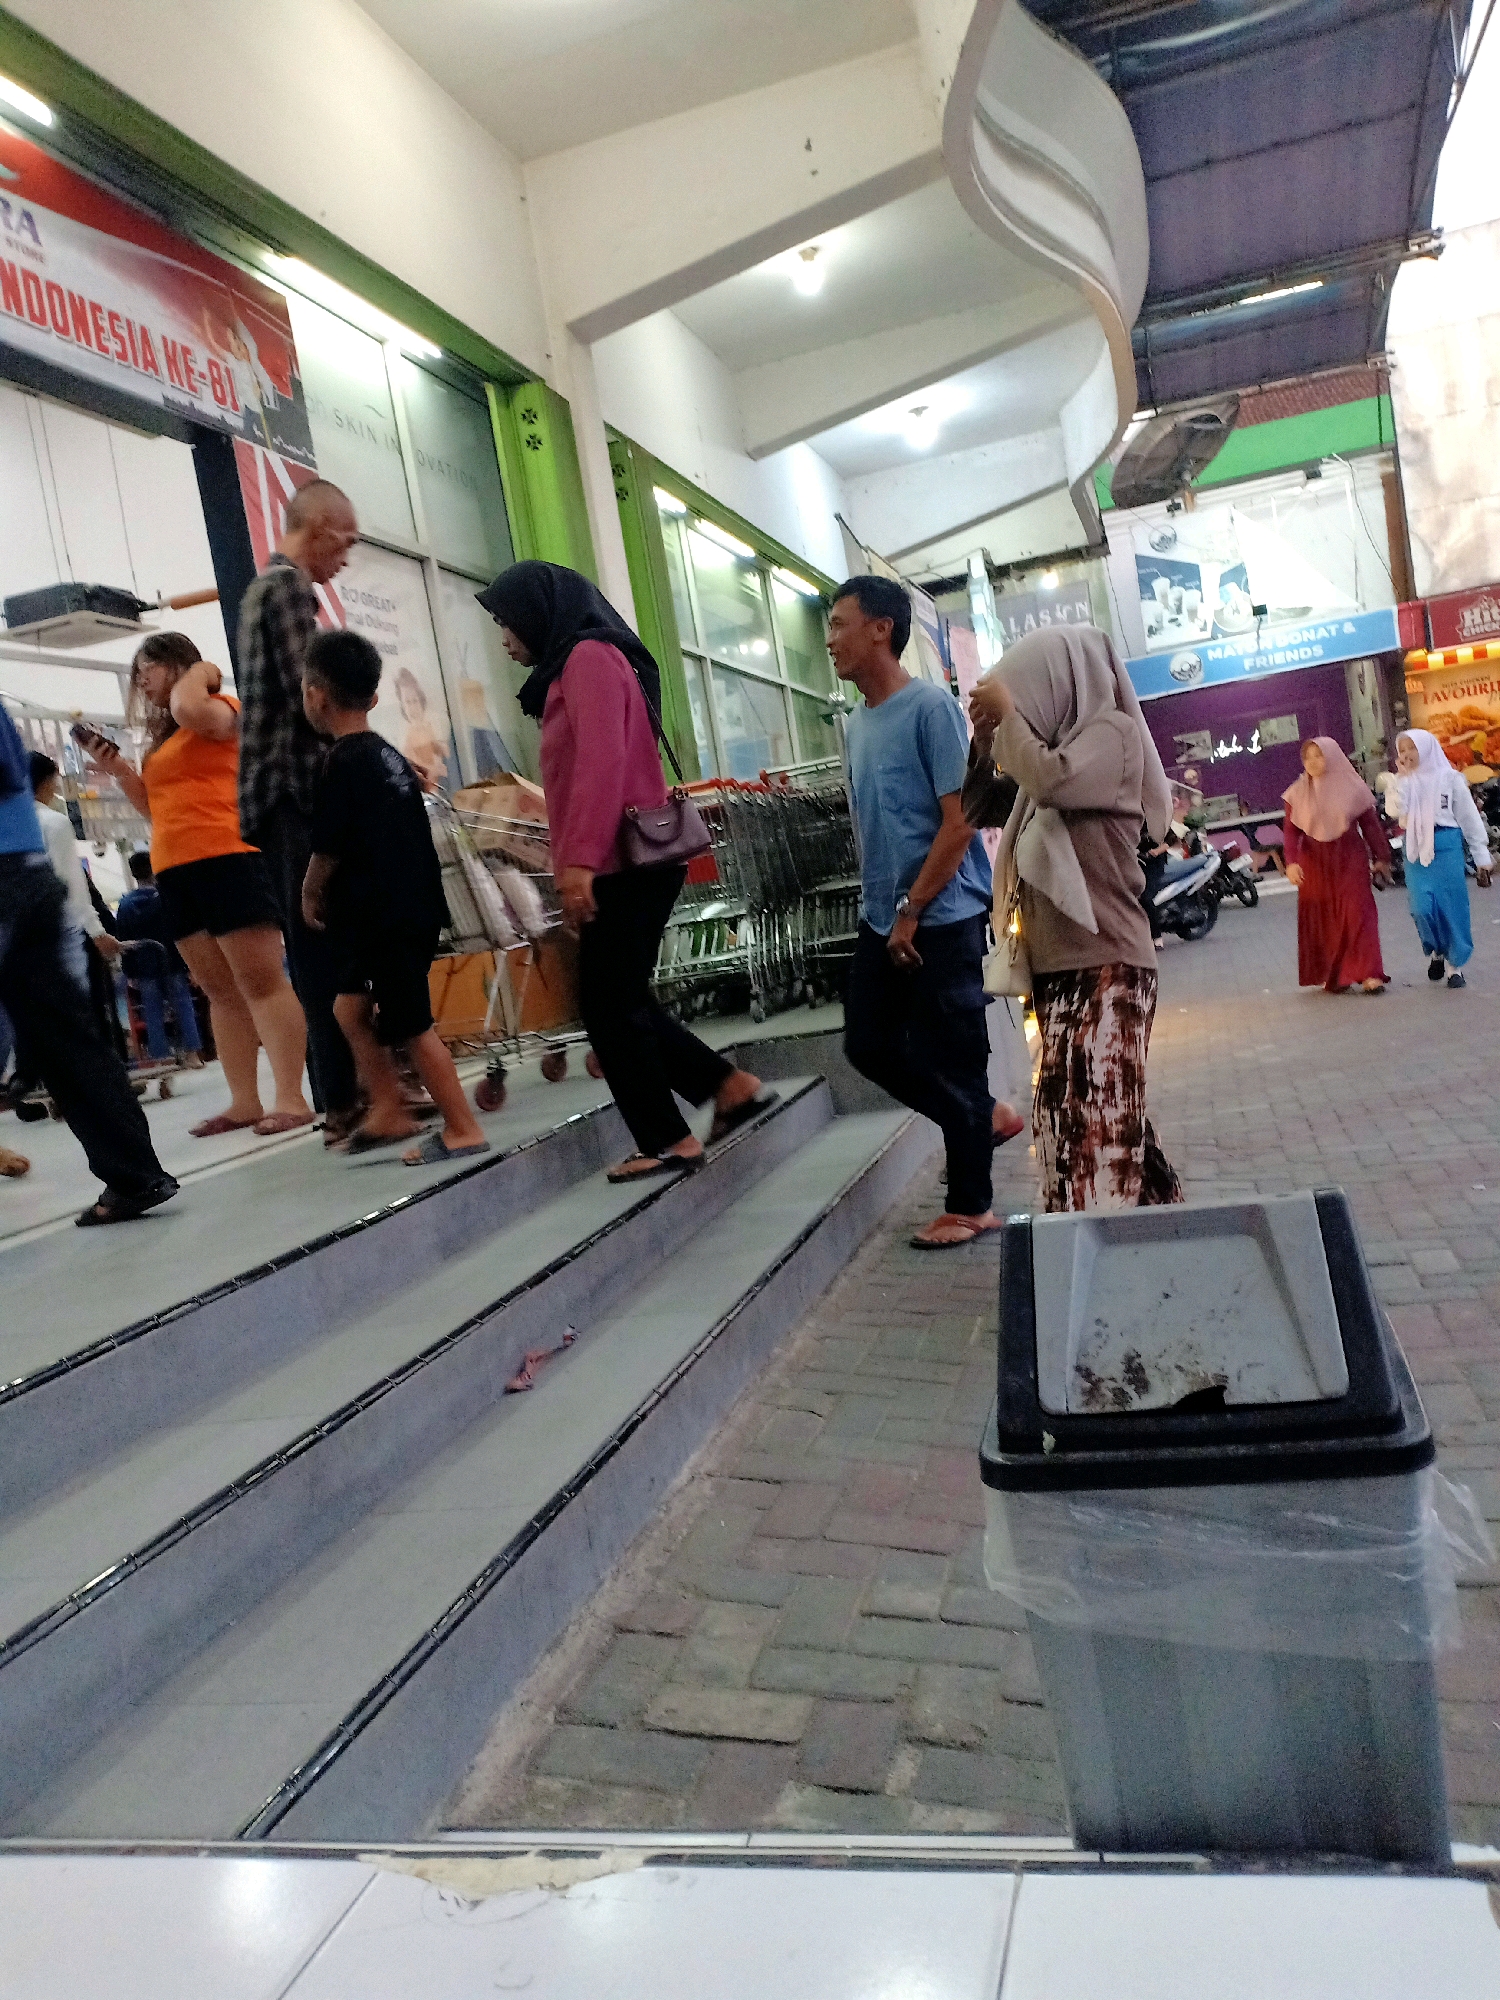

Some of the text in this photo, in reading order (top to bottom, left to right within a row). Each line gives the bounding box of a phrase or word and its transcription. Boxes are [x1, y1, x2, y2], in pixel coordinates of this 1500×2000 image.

[1274, 624, 1340, 649] DONAT
[1342, 621, 1356, 634] &
[1243, 644, 1325, 672] FRIENDS
